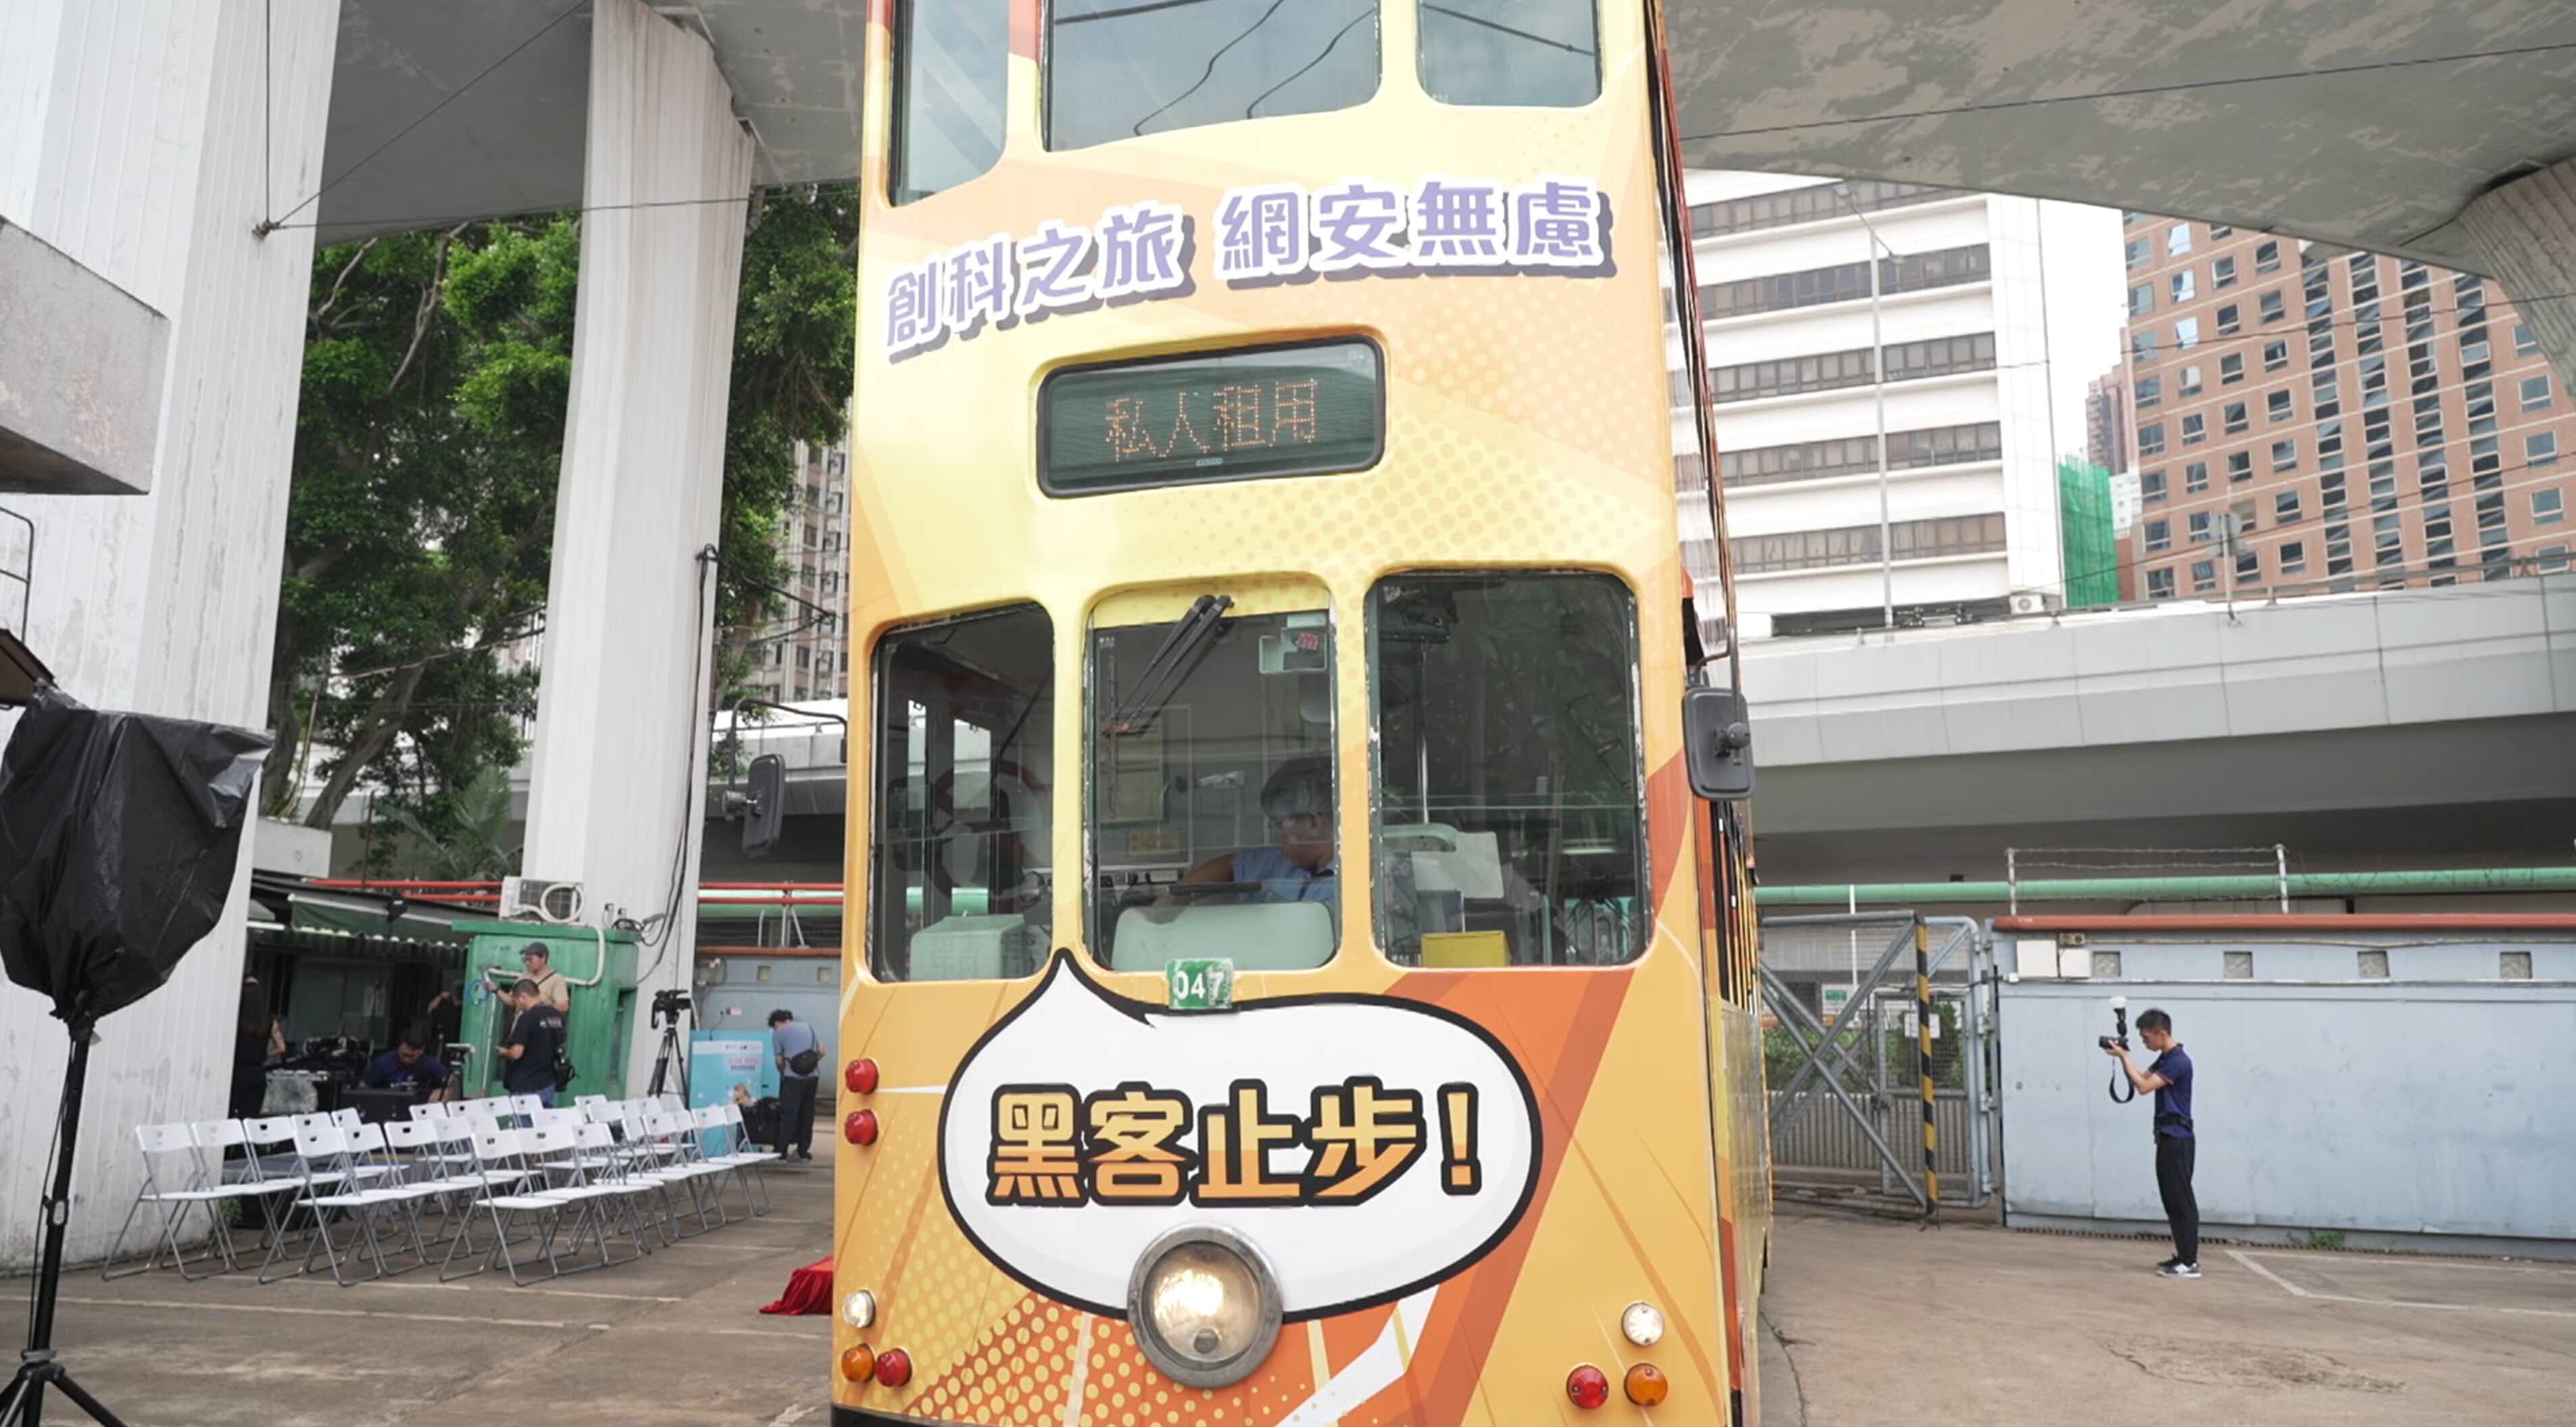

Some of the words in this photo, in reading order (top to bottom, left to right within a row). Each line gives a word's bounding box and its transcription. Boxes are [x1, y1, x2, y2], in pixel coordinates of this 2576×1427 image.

[885, 203, 1185, 349] 創科之旅
[1220, 180, 1601, 272] 網安無慮
[1106, 378, 1318, 462] 私人租用
[1172, 970, 1224, 1000] 047
[988, 1077, 1481, 1205] 黑客止步!
